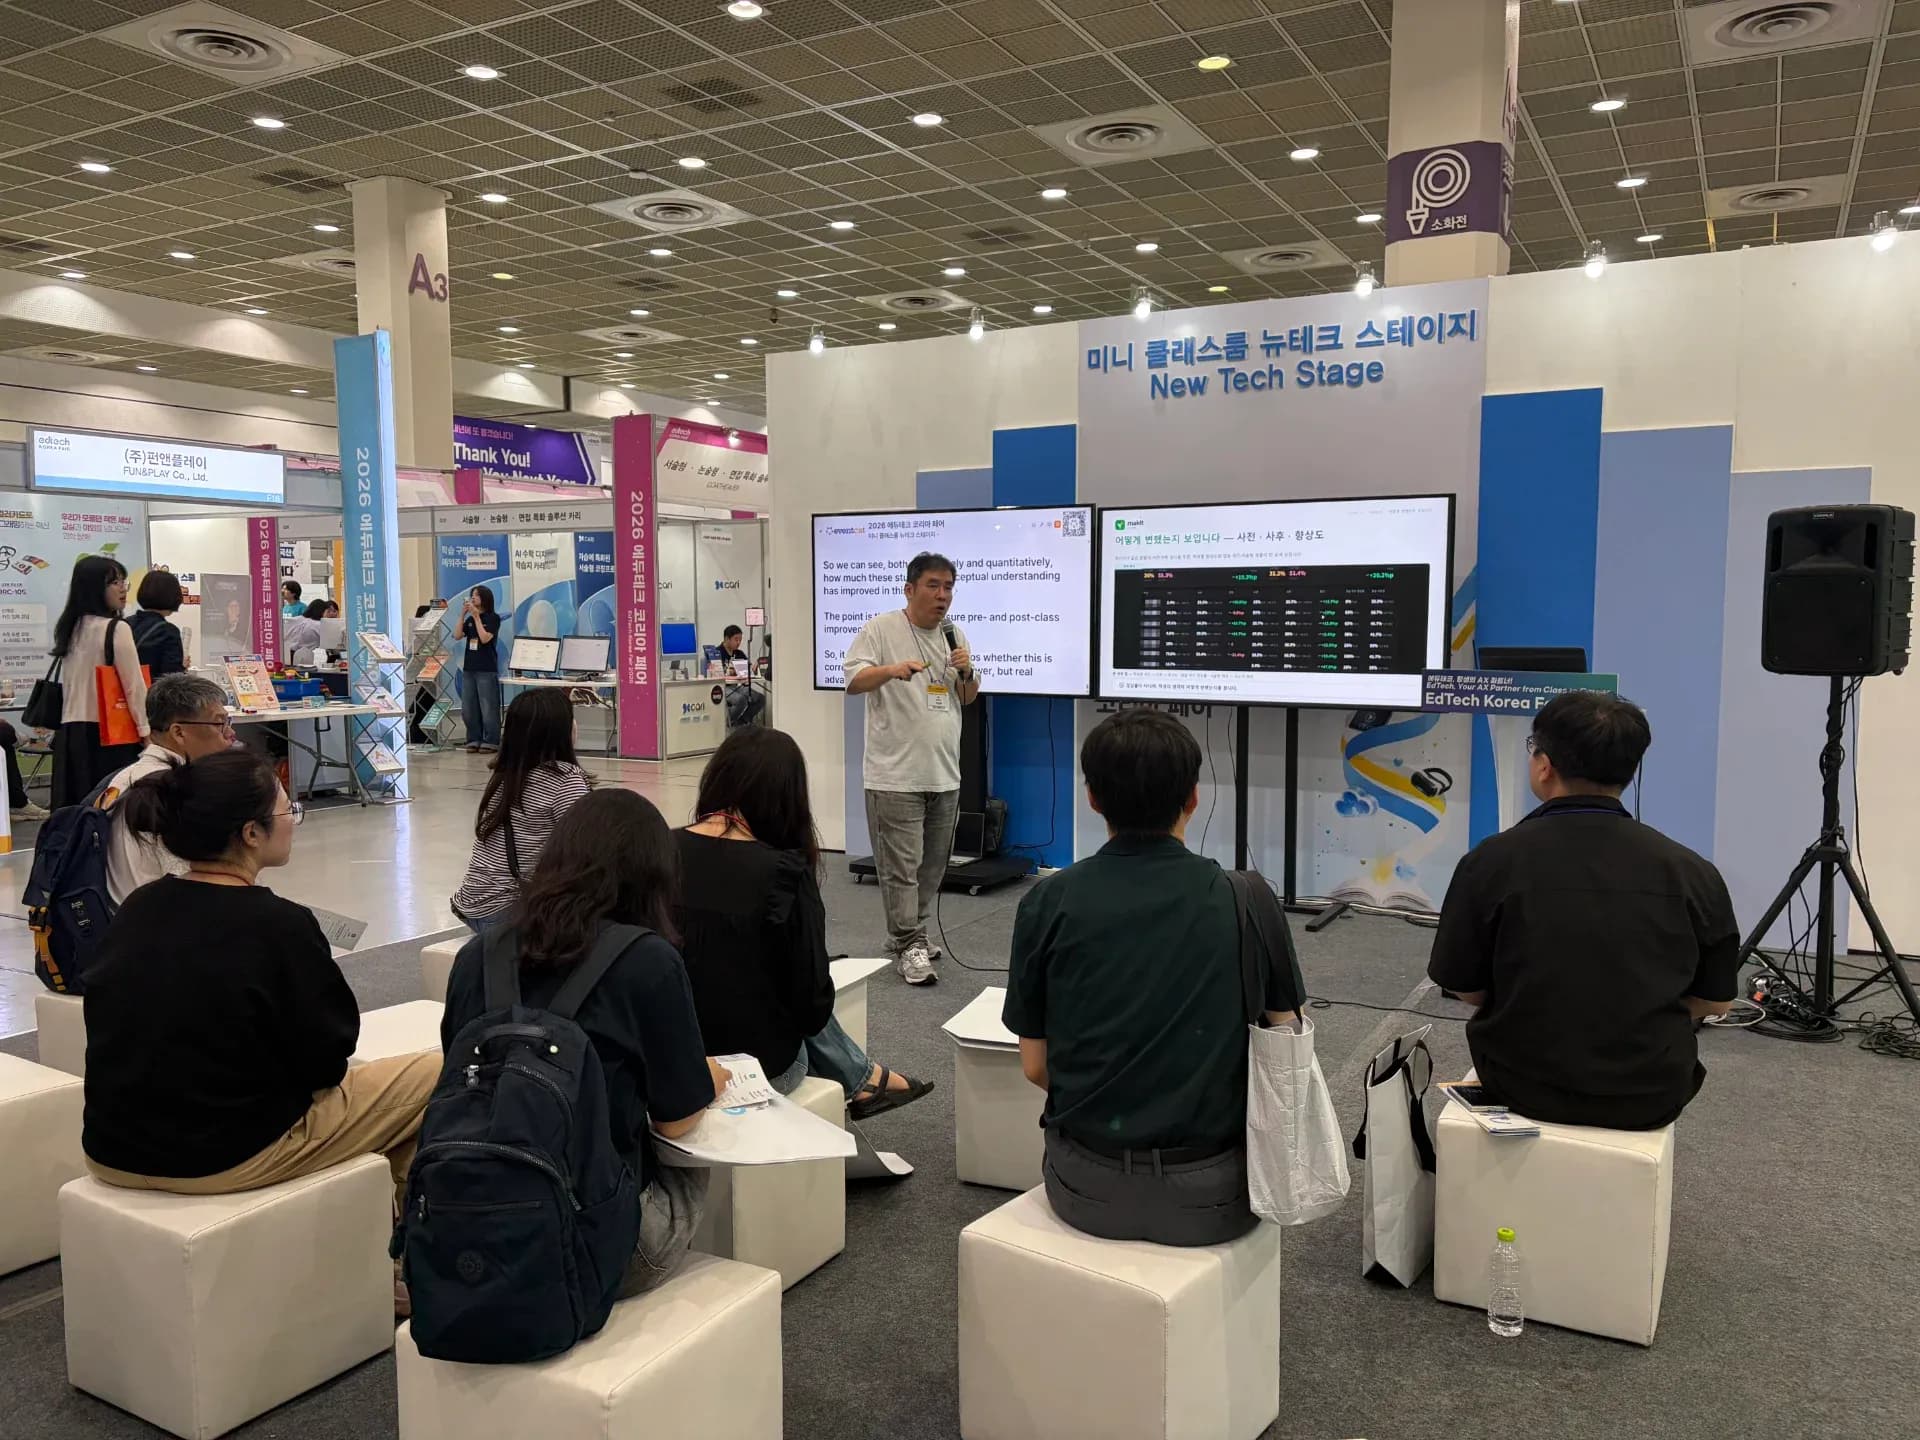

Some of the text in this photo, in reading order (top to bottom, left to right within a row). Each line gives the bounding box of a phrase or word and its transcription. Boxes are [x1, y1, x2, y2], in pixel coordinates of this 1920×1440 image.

[1431, 215, 1467, 231] 소화전
[408, 252, 448, 303] A3
[1087, 308, 1479, 372] 미니 클래스룸 뉴테크 스테이지
[1150, 358, 1384, 400] New Tech Stage
[39, 436, 71, 446] edtech
[124, 448, 207, 470] (주)펀앤플레이
[454, 443, 530, 467] Thank You!
[123, 467, 170, 478] FUN&PLAY
[192, 471, 208, 482] Ltd.
[357, 447, 371, 507] 2026
[568, 512, 581, 520] 카리
[259, 519, 270, 550] 026
[1115, 535, 1141, 545] 어떻게
[1184, 532, 1220, 544] 보입니다
[1237, 531, 1256, 542] 사전
[1265, 530, 1285, 541] 사후
[1295, 529, 1325, 541] 향상도
[359, 513, 375, 587] 에듀테크
[823, 561, 835, 569] So
[868, 561, 886, 570] see,
[966, 558, 984, 568] and
[986, 557, 1053, 569] quantitatively,
[261, 554, 272, 604] 에듀테크
[724, 580, 740, 589] cari
[823, 573, 841, 582] how
[843, 573, 867, 582] much
[869, 573, 893, 582] these
[991, 571, 1061, 582] understanding
[631, 490, 647, 685] 2026 에듀테크 코리아 페어
[823, 586, 838, 595] has
[841, 586, 880, 597] improved
[882, 586, 890, 594] in
[824, 612, 841, 621] The
[842, 611, 863, 623] point
[865, 611, 873, 620] is
[968, 613, 987, 623] pre-
[990, 612, 1007, 621] and
[1009, 612, 1060, 624] post-class
[263, 608, 273, 644] 코리아
[824, 650, 838, 660] So,
[983, 653, 1022, 662] whether
[1024, 653, 1042, 662] this
[1044, 653, 1053, 662] is
[997, 666, 1013, 676] but
[1015, 667, 1033, 676] real
[1477, 676, 1489, 684] AX
[1490, 684, 1521, 692] Partner
[1522, 685, 1542, 694] from
[1543, 686, 1567, 694] Class
[690, 702, 705, 711] cari
[1425, 692, 1480, 707] EdTech
[1484, 693, 1530, 710] Korea
